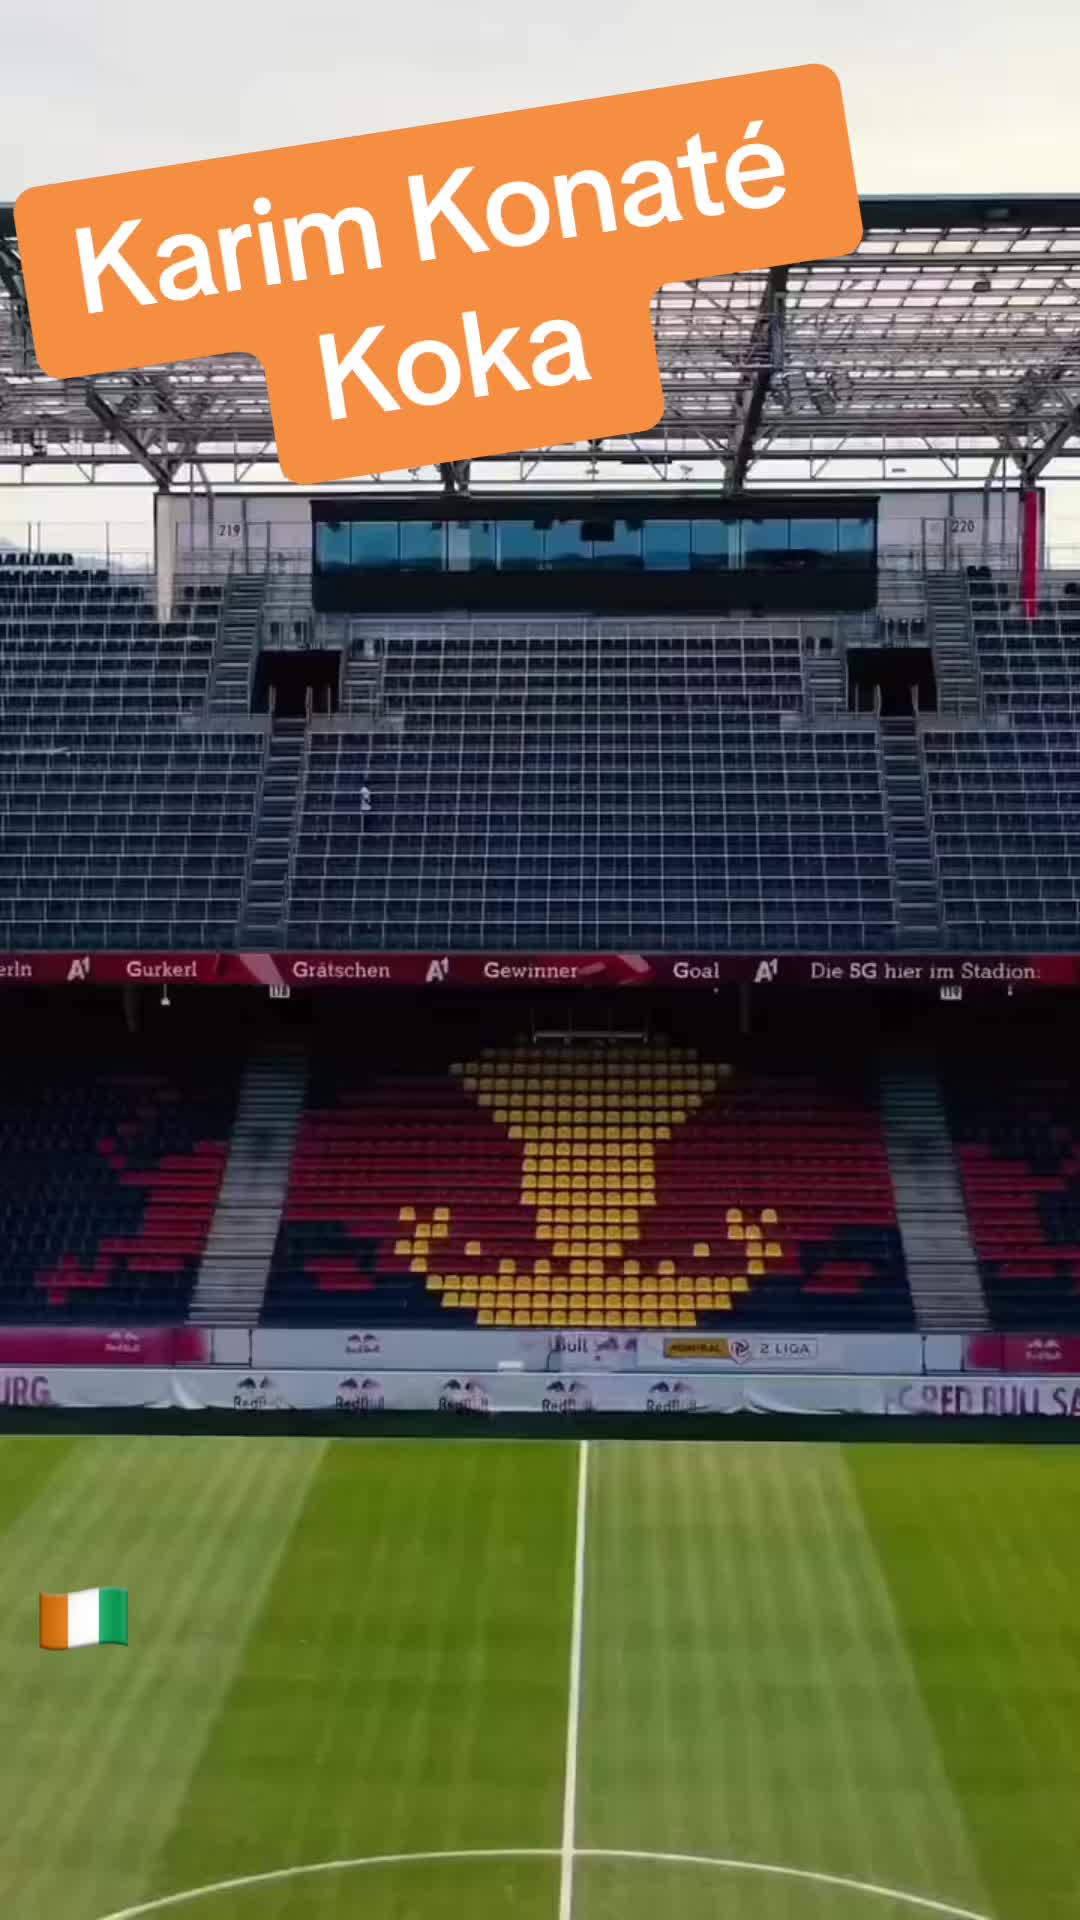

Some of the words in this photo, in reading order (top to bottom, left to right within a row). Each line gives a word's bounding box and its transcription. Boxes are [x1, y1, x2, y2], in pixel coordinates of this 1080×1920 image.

[217, 524, 241, 537] 219
[951, 519, 975, 534] 220
[126, 960, 198, 978] Gurkerl
[292, 960, 391, 979] Grätschen
[484, 961, 577, 979] Gewinner
[673, 961, 720, 979] Goal
[811, 962, 844, 979] Die
[884, 962, 922, 979] hier
[930, 962, 953, 979] im
[775, 1343, 810, 1355] LIGA
